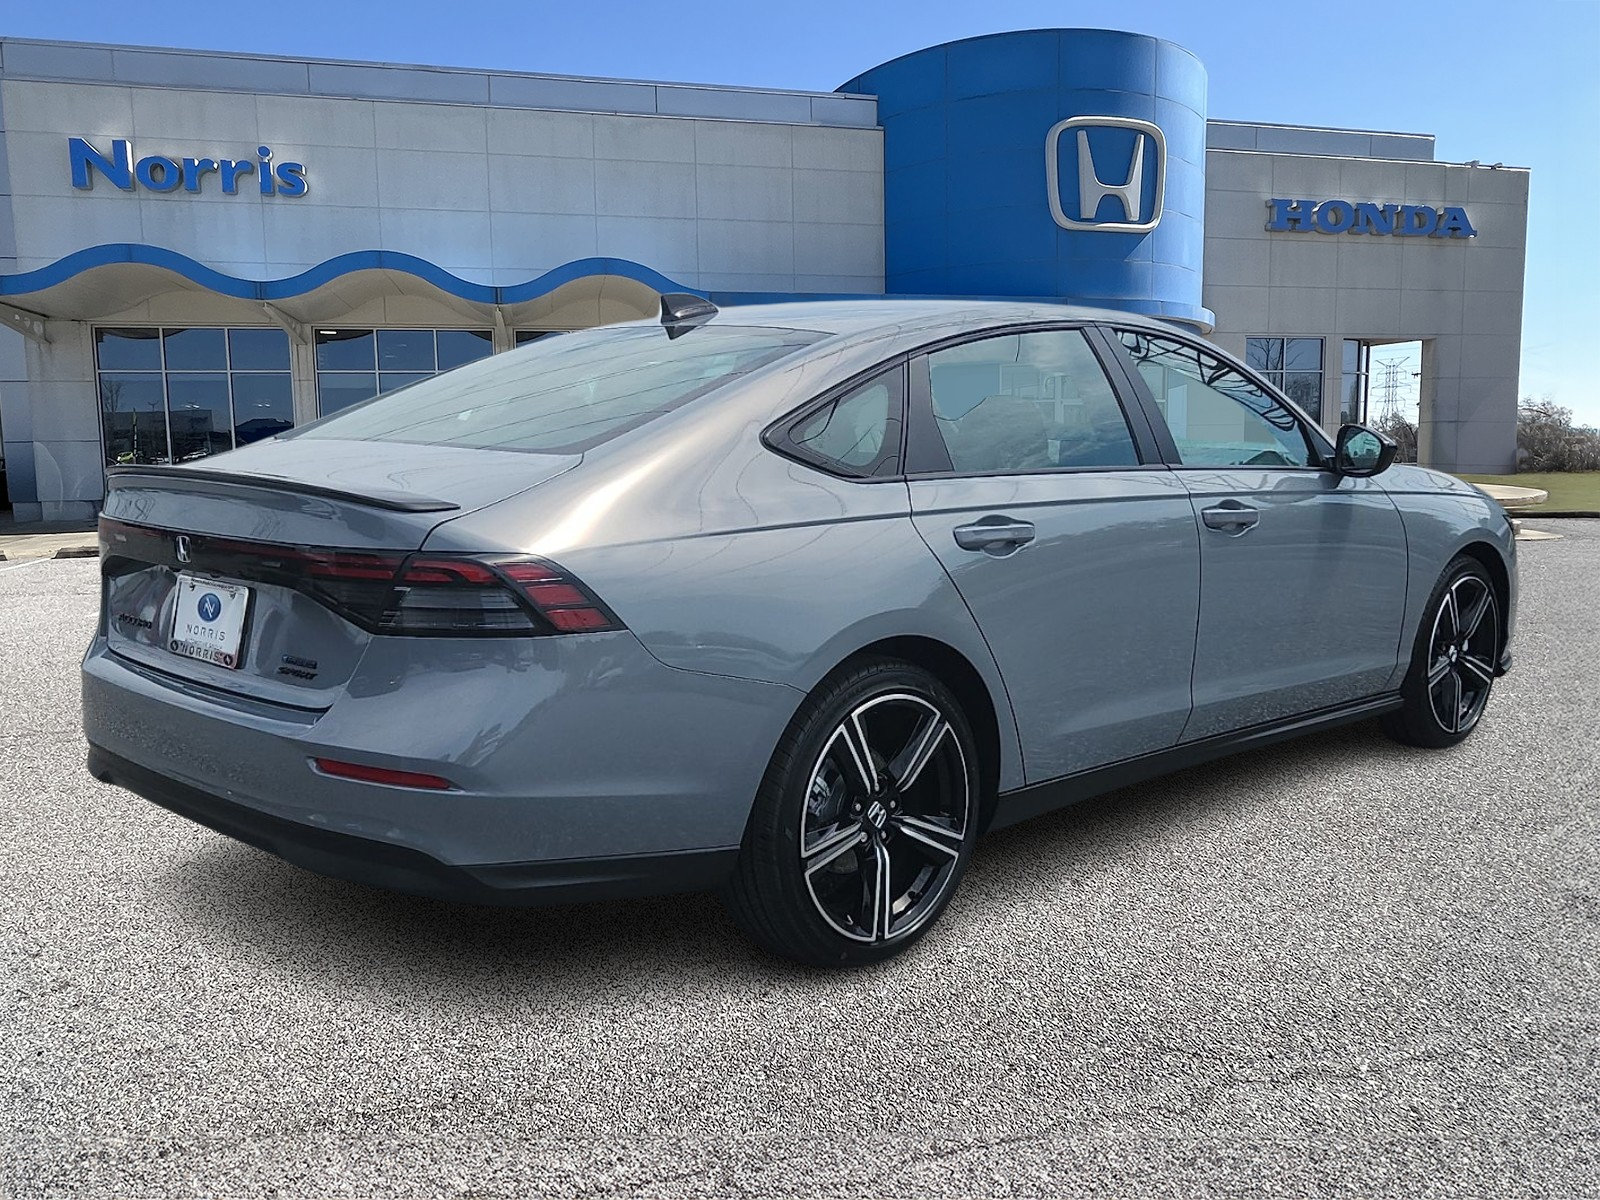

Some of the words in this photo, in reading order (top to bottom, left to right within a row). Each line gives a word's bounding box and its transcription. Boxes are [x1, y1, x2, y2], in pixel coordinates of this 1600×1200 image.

[67, 137, 309, 197] Norris
[1265, 197, 1478, 239] HONDA
[185, 624, 226, 641] NORRIS
